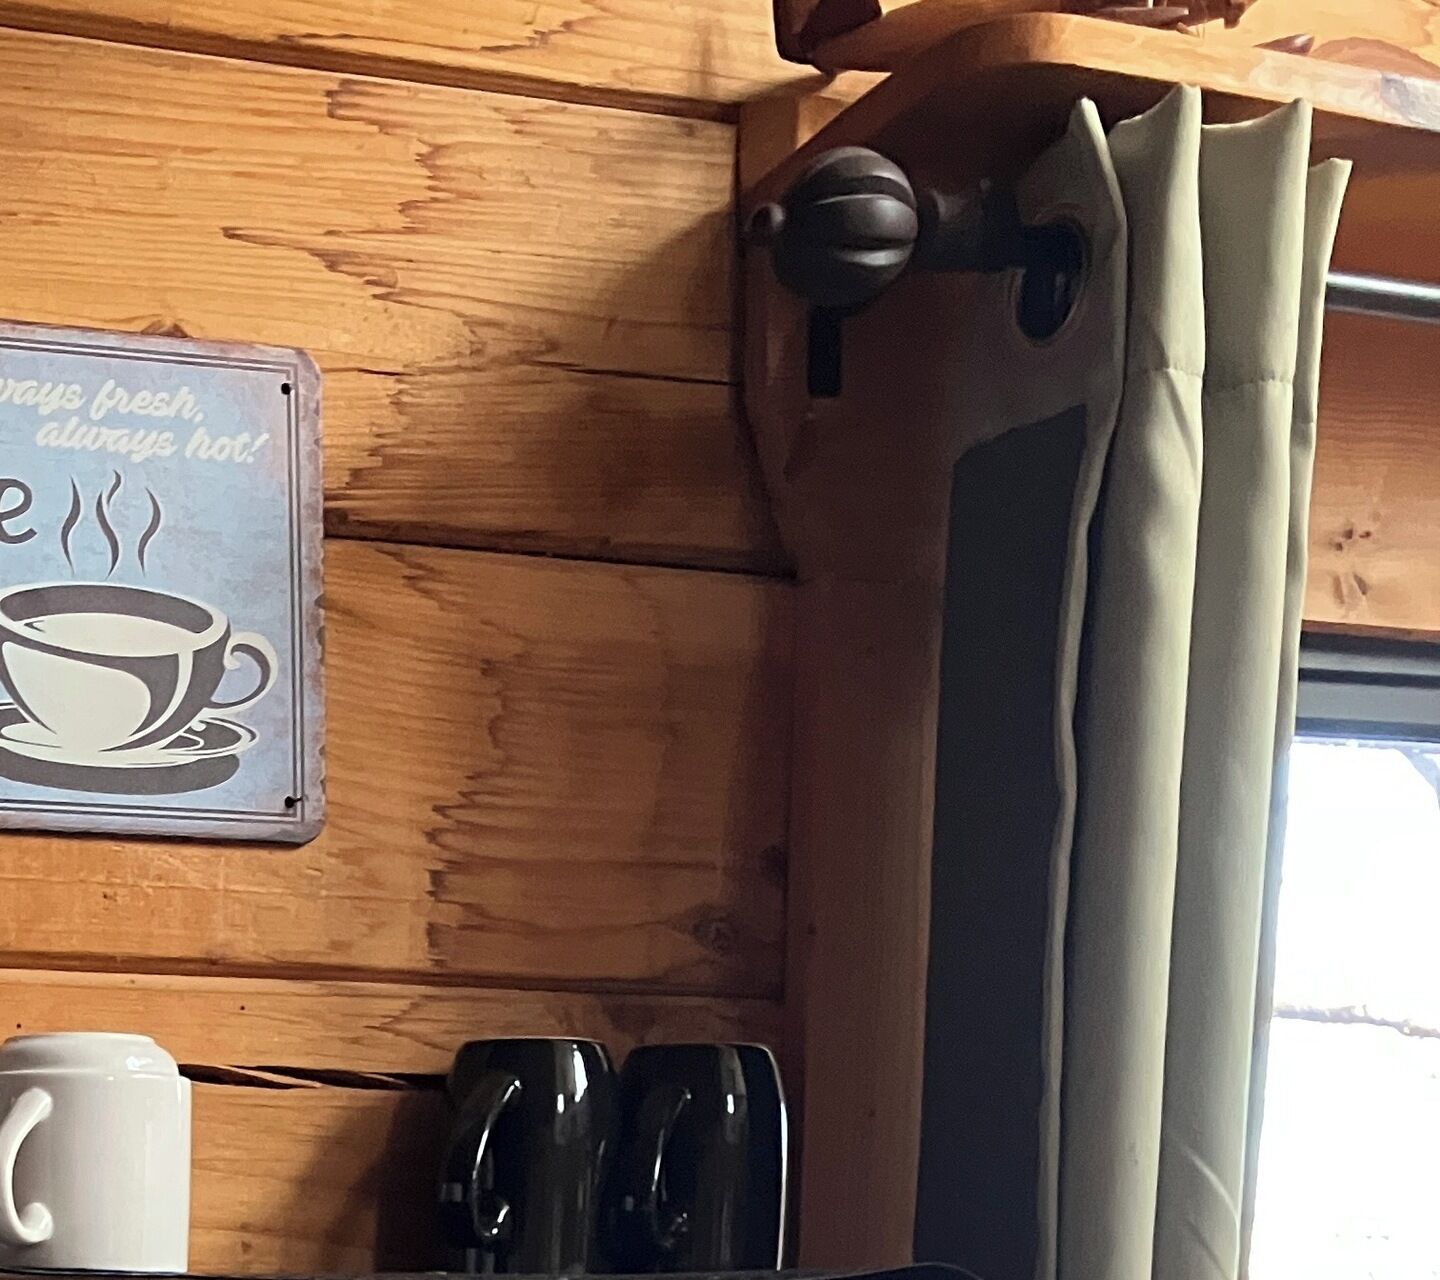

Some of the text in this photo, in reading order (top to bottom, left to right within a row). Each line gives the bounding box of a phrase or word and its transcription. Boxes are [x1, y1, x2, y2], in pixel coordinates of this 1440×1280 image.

[89, 378, 204, 422] fresh,
[35, 416, 271, 463] always hot!
